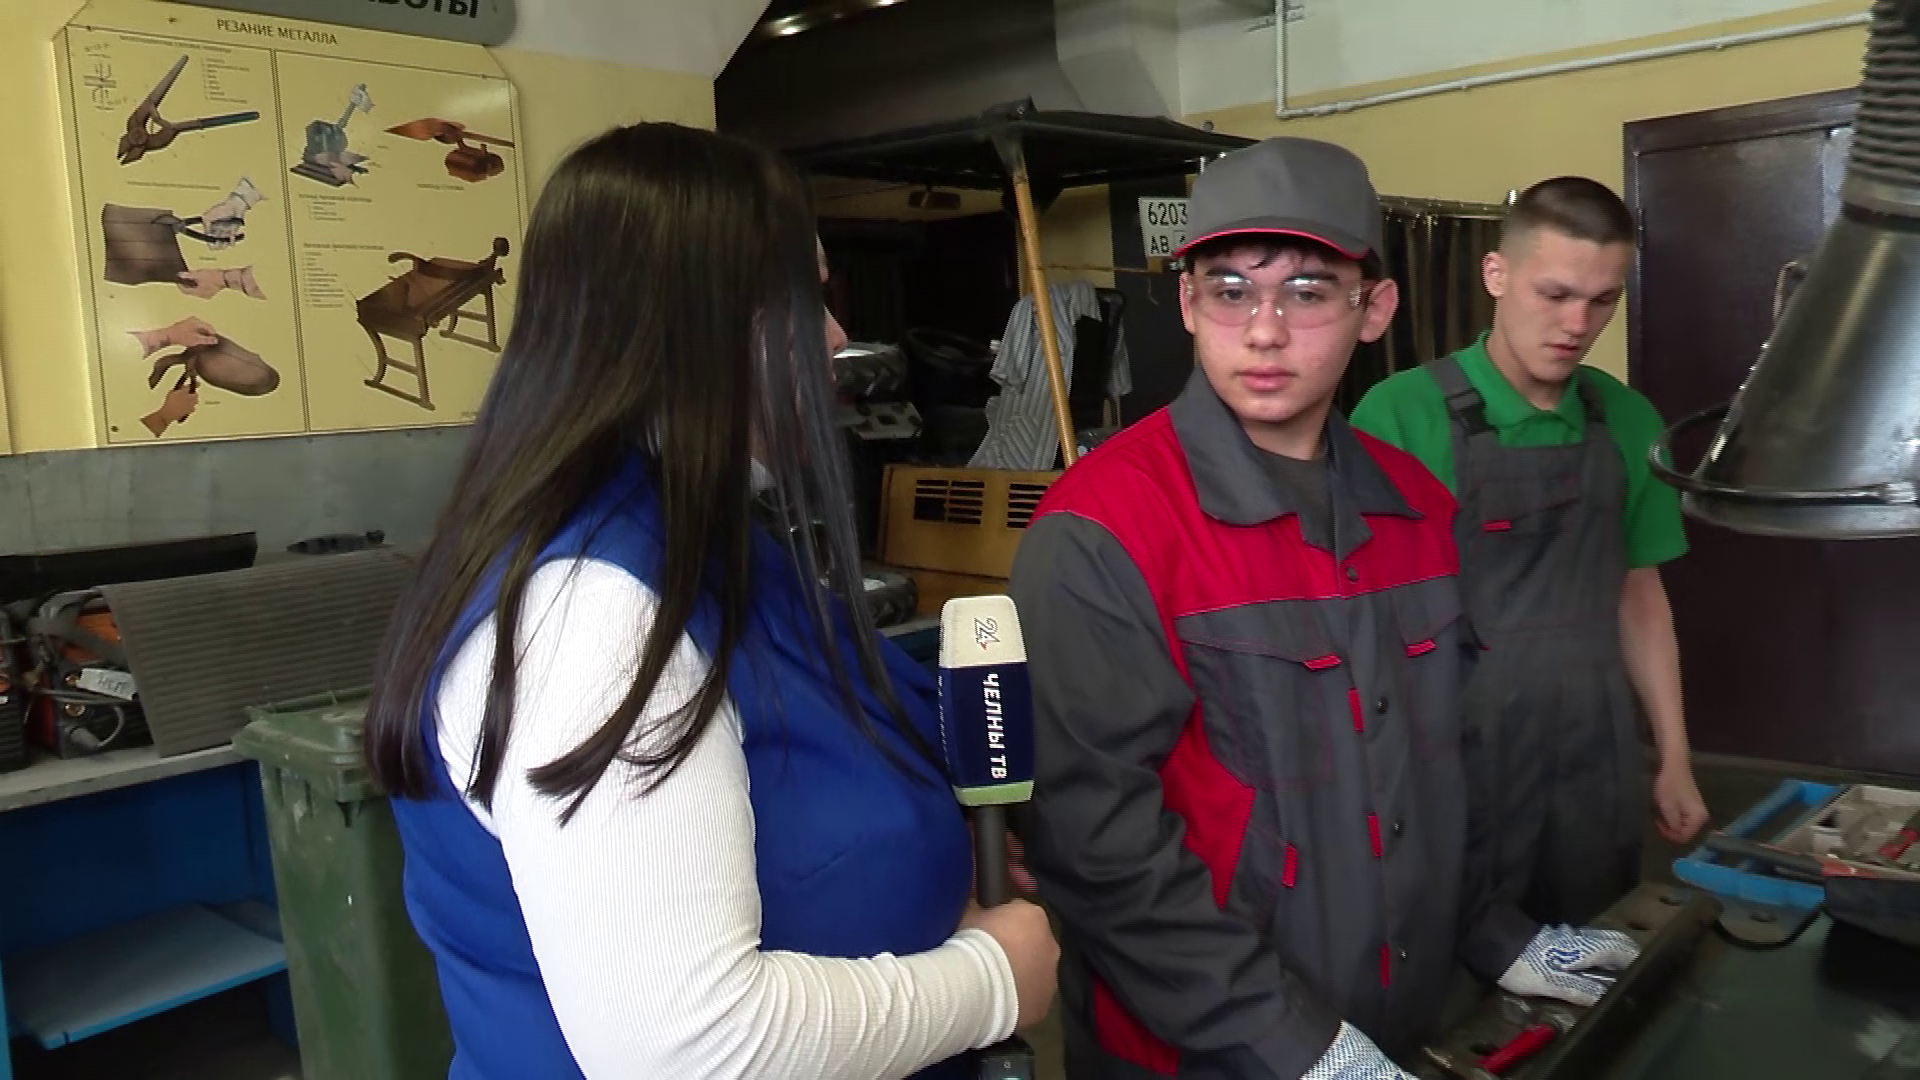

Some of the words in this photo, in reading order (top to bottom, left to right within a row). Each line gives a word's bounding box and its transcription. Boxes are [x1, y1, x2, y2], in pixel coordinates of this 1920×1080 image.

[216, 18, 273, 37] РЕЗАНИЕ
[277, 27, 338, 45] МЕТАЛЛА
[1147, 202, 1188, 226] 6203
[982, 673, 1005, 749] ЧЕЛНЫ
[990, 754, 1008, 779] ТВ
